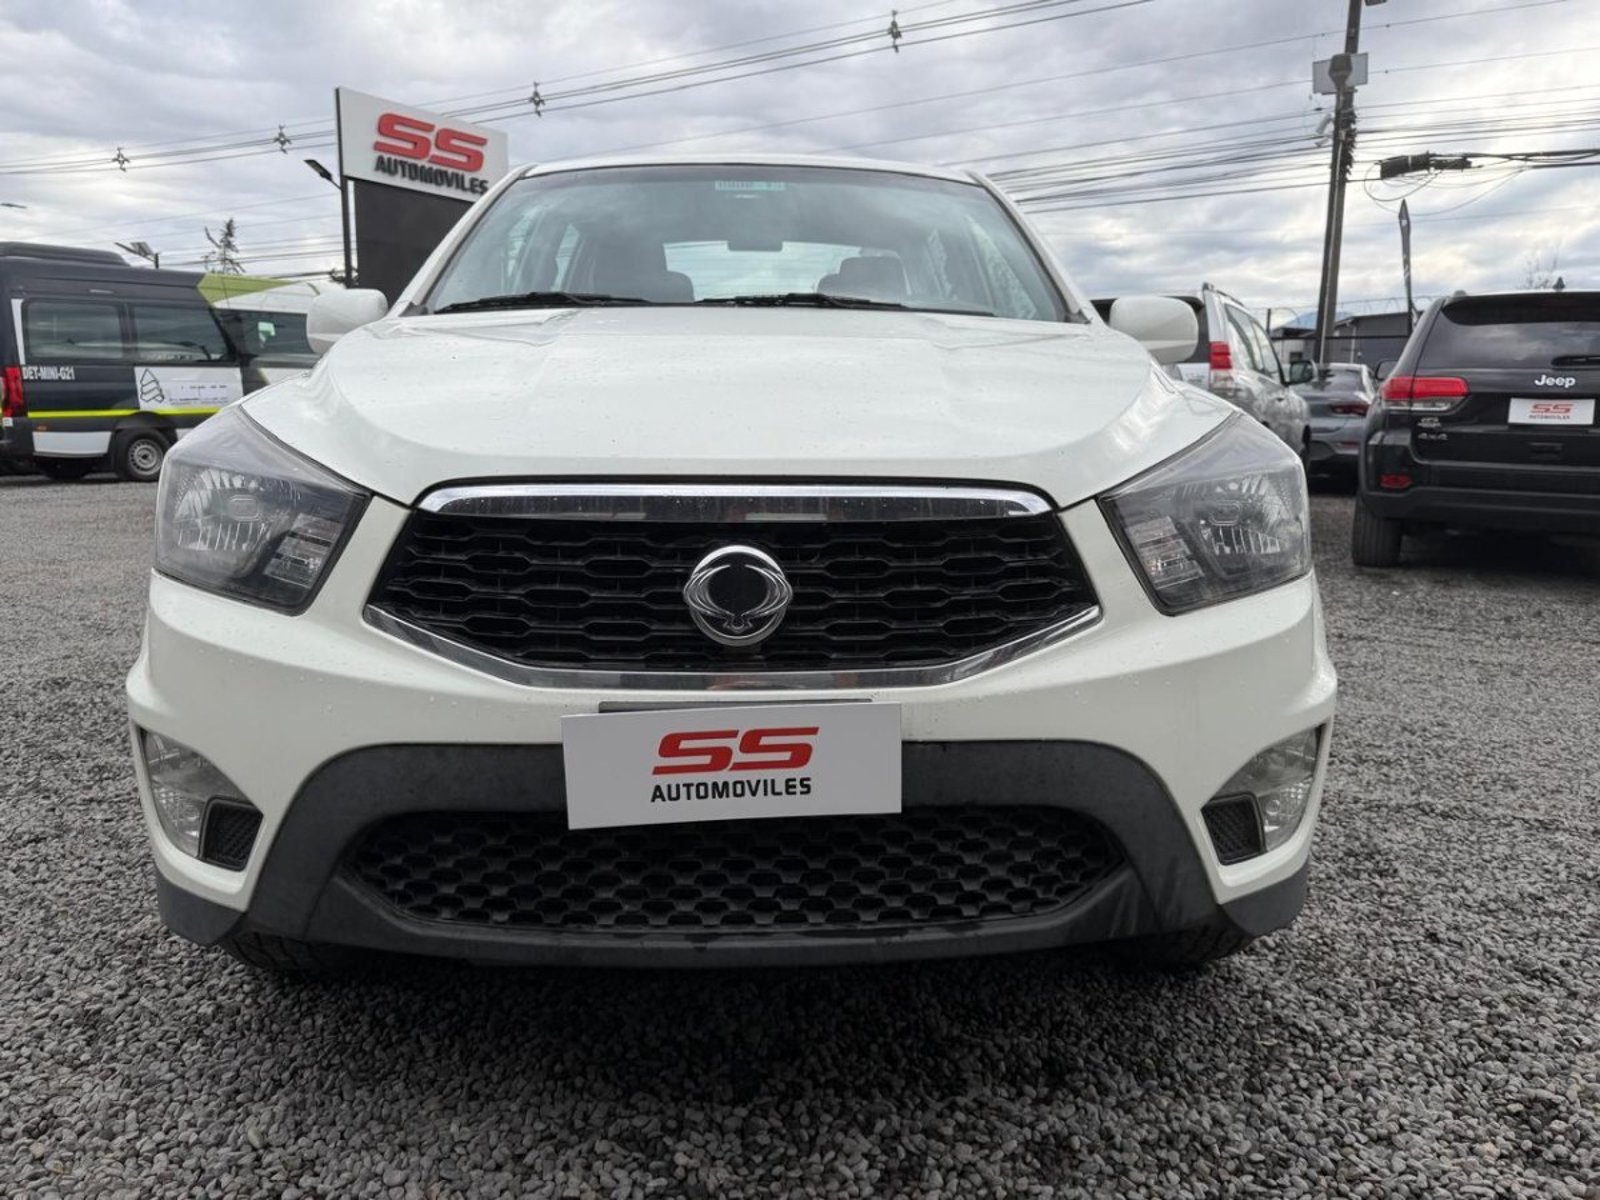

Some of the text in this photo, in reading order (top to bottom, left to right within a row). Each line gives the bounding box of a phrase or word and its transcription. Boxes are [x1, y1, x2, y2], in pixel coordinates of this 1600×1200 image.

[373, 112, 488, 172] SS
[374, 154, 489, 196] AUTOMOVILES
[1534, 374, 1576, 388] Jeep
[1530, 403, 1574, 413] SS
[652, 726, 820, 776] SS
[650, 776, 812, 803] AUTOMOVILES
